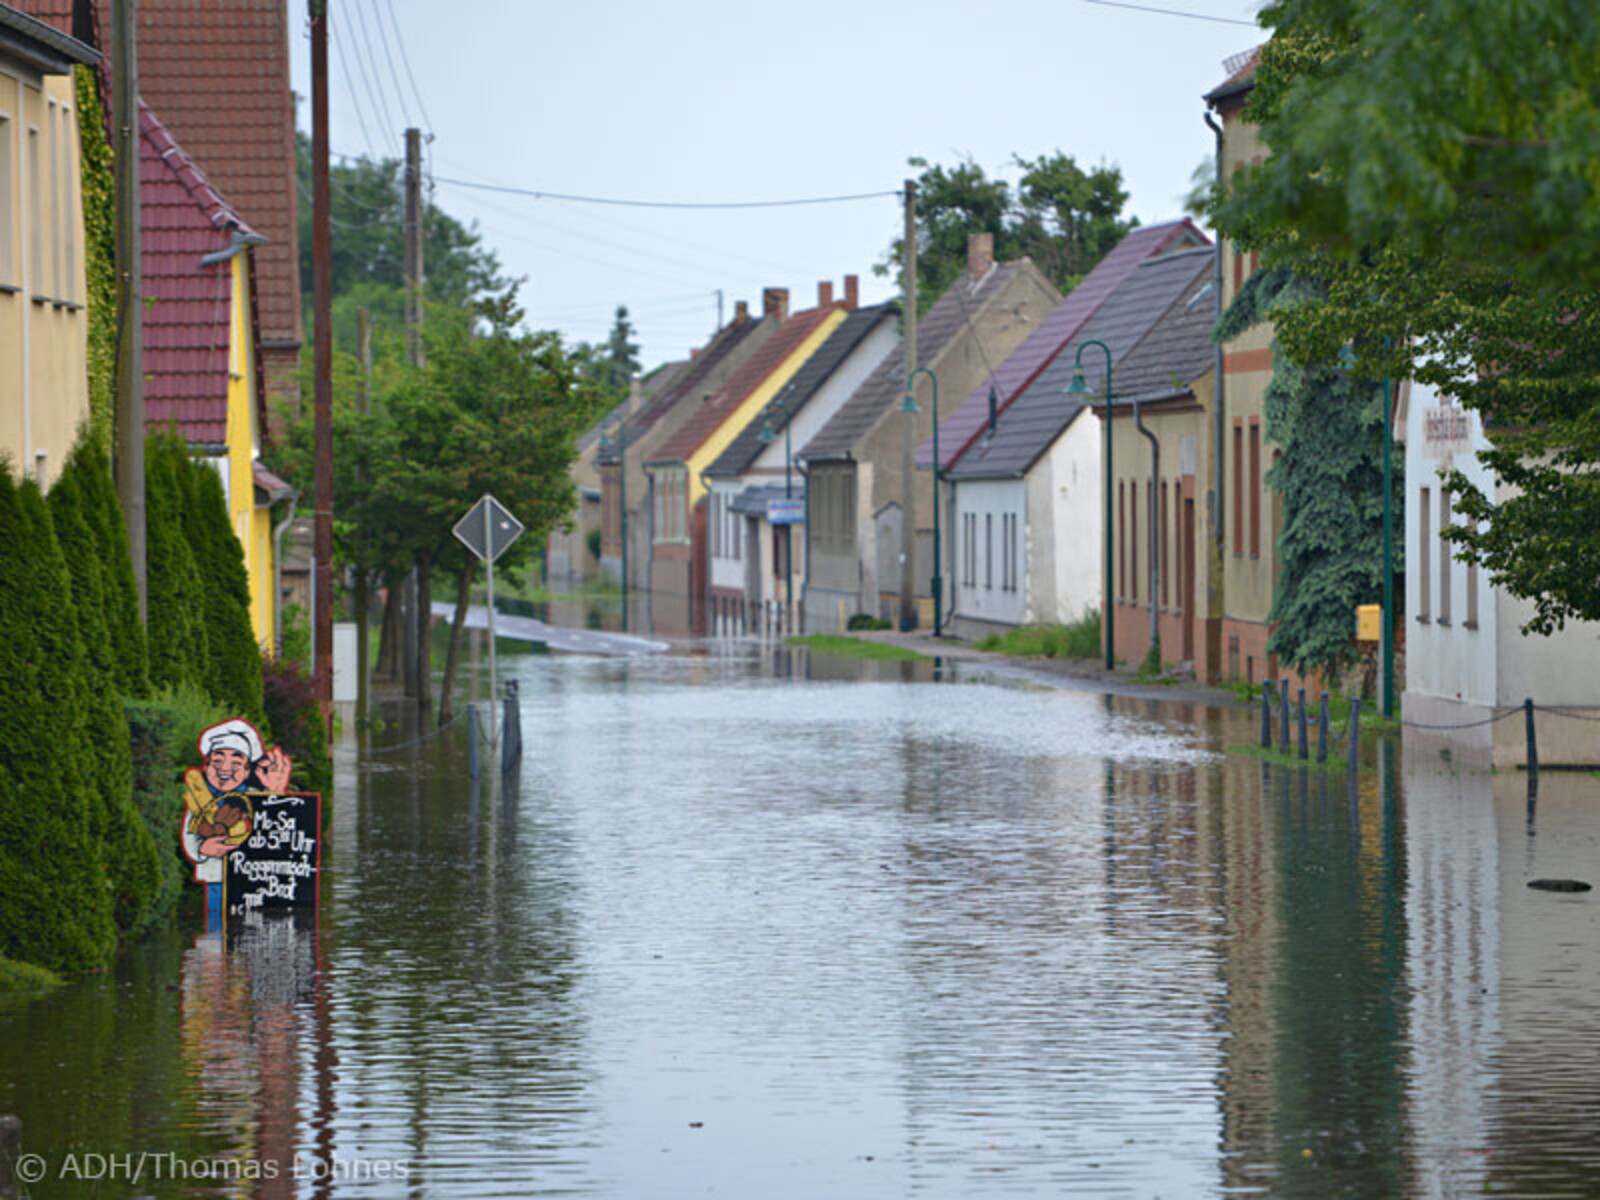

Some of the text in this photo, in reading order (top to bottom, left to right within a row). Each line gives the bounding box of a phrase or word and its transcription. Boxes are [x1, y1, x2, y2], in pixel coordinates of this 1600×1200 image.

[253, 810, 296, 831] Mo-Sa
[248, 830, 267, 848] ab
[291, 830, 316, 853] Uhr
[263, 875, 297, 901] Brot
